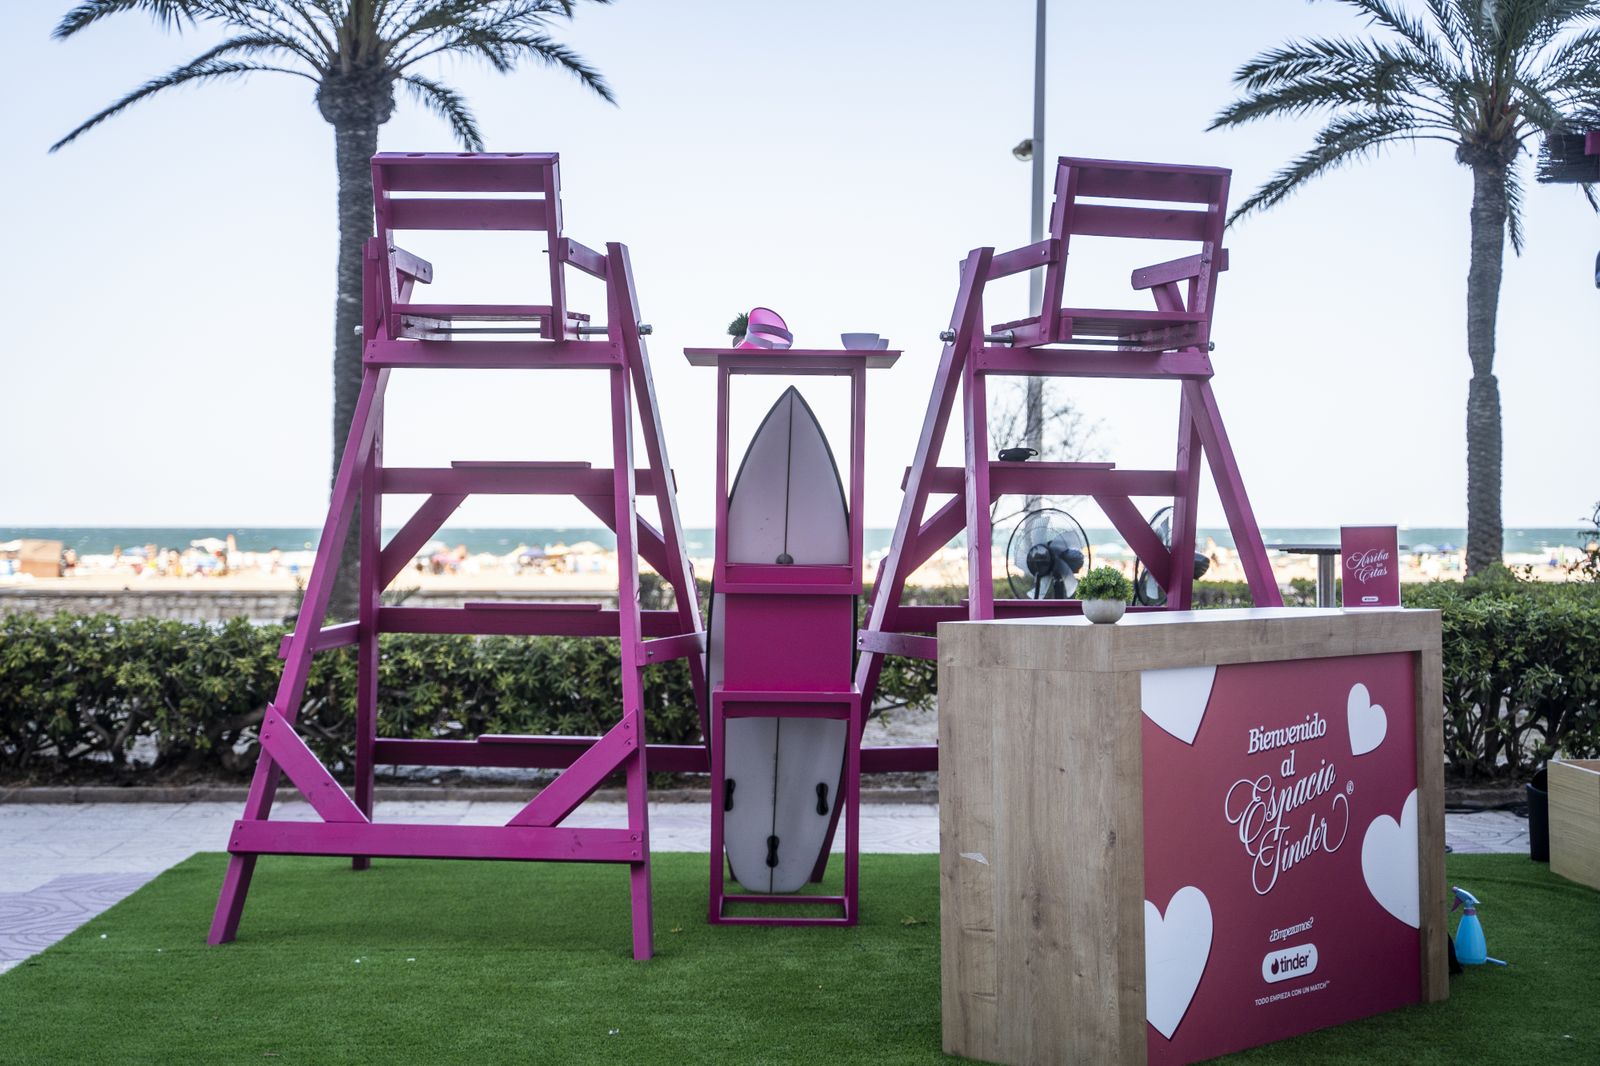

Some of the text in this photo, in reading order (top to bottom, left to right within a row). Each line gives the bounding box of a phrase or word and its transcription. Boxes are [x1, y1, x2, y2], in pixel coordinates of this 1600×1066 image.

[1248, 712, 1327, 754] Bienvenido
[1281, 749, 1296, 777] al
[1225, 759, 1336, 856] Espacio
[1280, 953, 1309, 972] tinder
[1255, 996, 1269, 1006] TODO
[1270, 991, 1290, 1003] EMPIEZA
[1291, 988, 1302, 997] CON
[1303, 986, 1310, 994] UN
